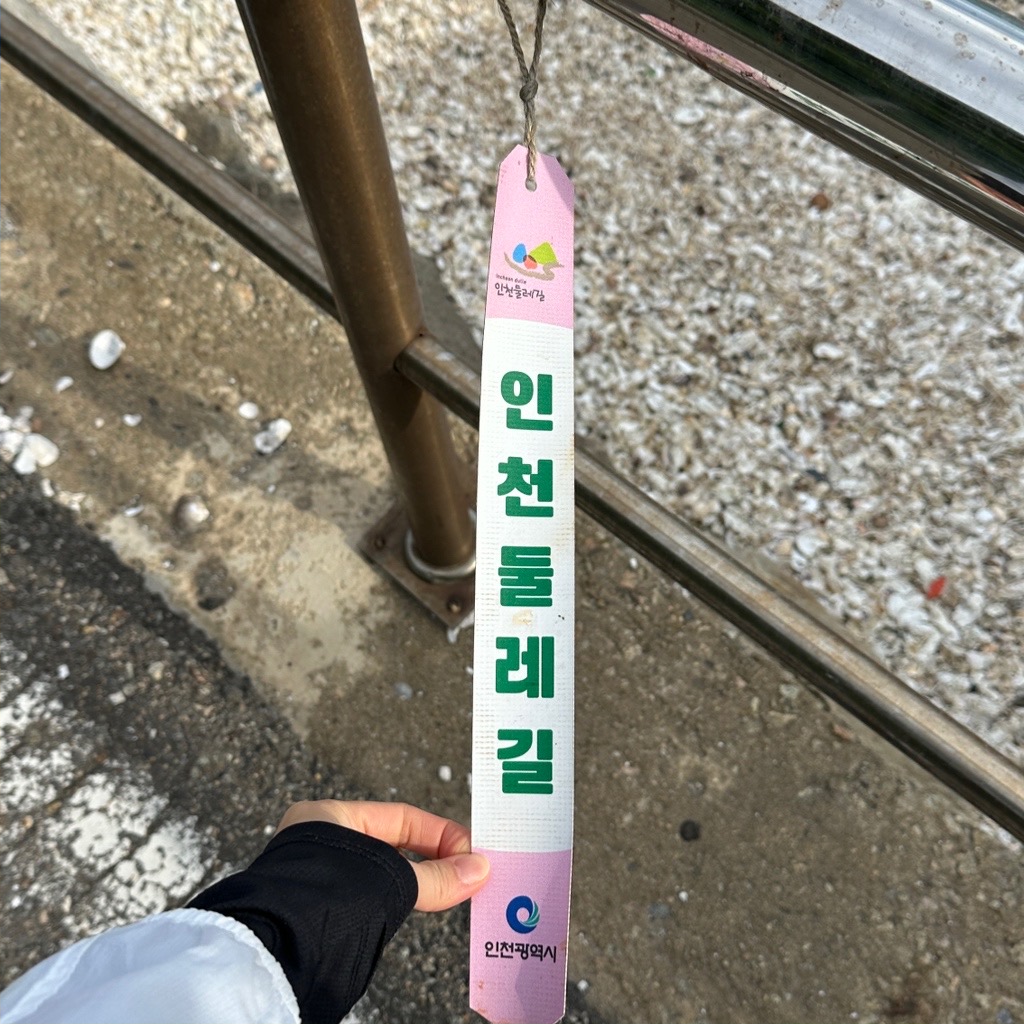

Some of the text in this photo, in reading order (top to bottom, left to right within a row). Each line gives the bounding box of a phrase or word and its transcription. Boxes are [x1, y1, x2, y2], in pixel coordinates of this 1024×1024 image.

[494, 282, 545, 302] 인천둘레길
[495, 370, 555, 795] 인천둘레길
[484, 941, 557, 963] 인천광역시
